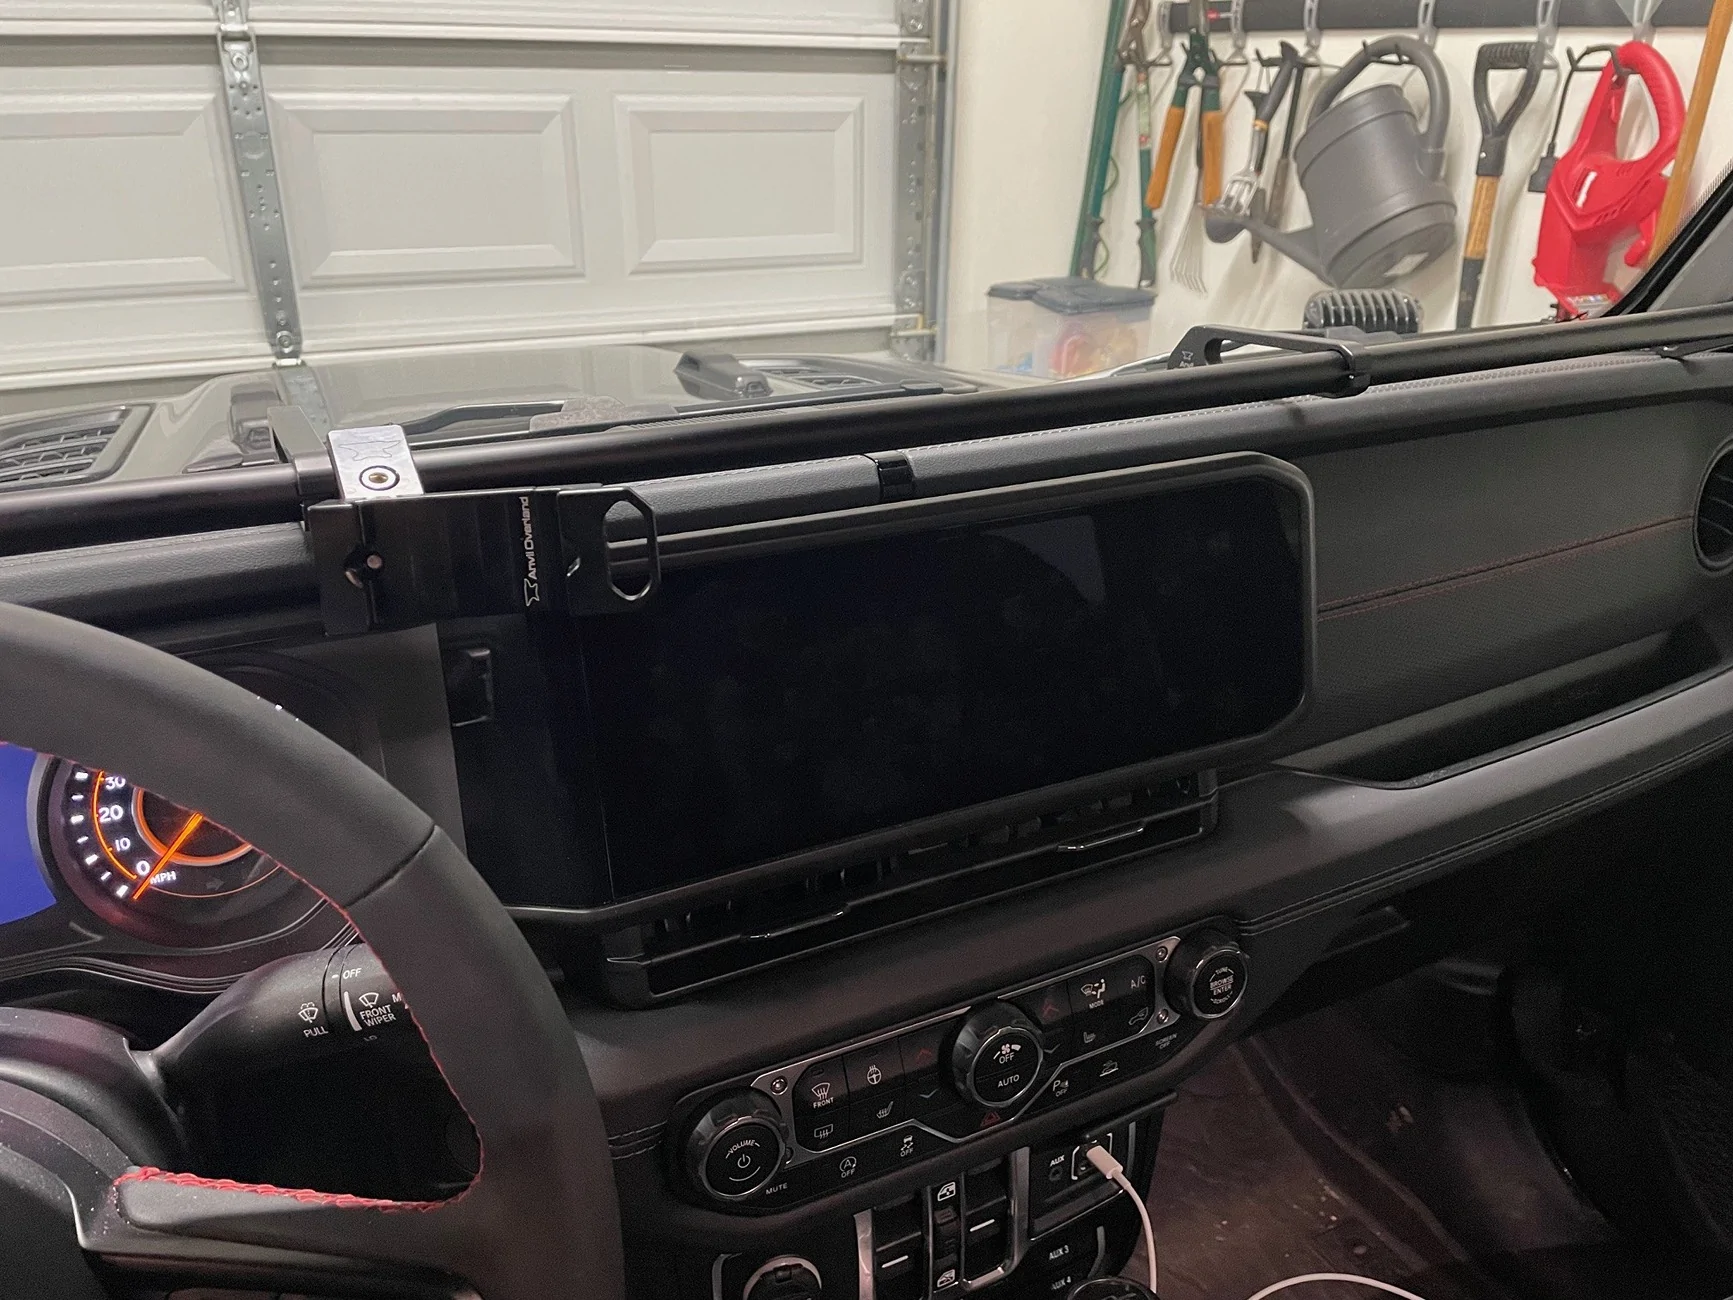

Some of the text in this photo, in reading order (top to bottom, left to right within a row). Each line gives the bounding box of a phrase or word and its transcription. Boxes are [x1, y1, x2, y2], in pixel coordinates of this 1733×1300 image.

[519, 496, 538, 580] Anvil Overland
[105, 776, 126, 790] 30
[98, 804, 123, 822] 20
[115, 837, 131, 851] 10
[136, 860, 150, 875] 0
[150, 870, 176, 884] MPH
[342, 968, 362, 979] OFF
[1130, 975, 1146, 989] A/C
[1213, 985, 1232, 995] ENTER
[360, 1004, 391, 1020] FRONT
[364, 1013, 396, 1027] WIPER
[303, 1026, 328, 1038] PULL
[999, 1052, 1015, 1064] OFF
[998, 1074, 1020, 1088] AUTO
[1055, 1088, 1068, 1097] OFF
[813, 1096, 834, 1109] FRONT
[728, 1139, 755, 1153] VOLUME
[900, 1147, 914, 1157] OFF
[1050, 1154, 1065, 1167] AUX
[841, 1168, 856, 1178] OFF
[765, 1182, 788, 1195] MUTE
[1049, 1244, 1070, 1260] AUX 3
